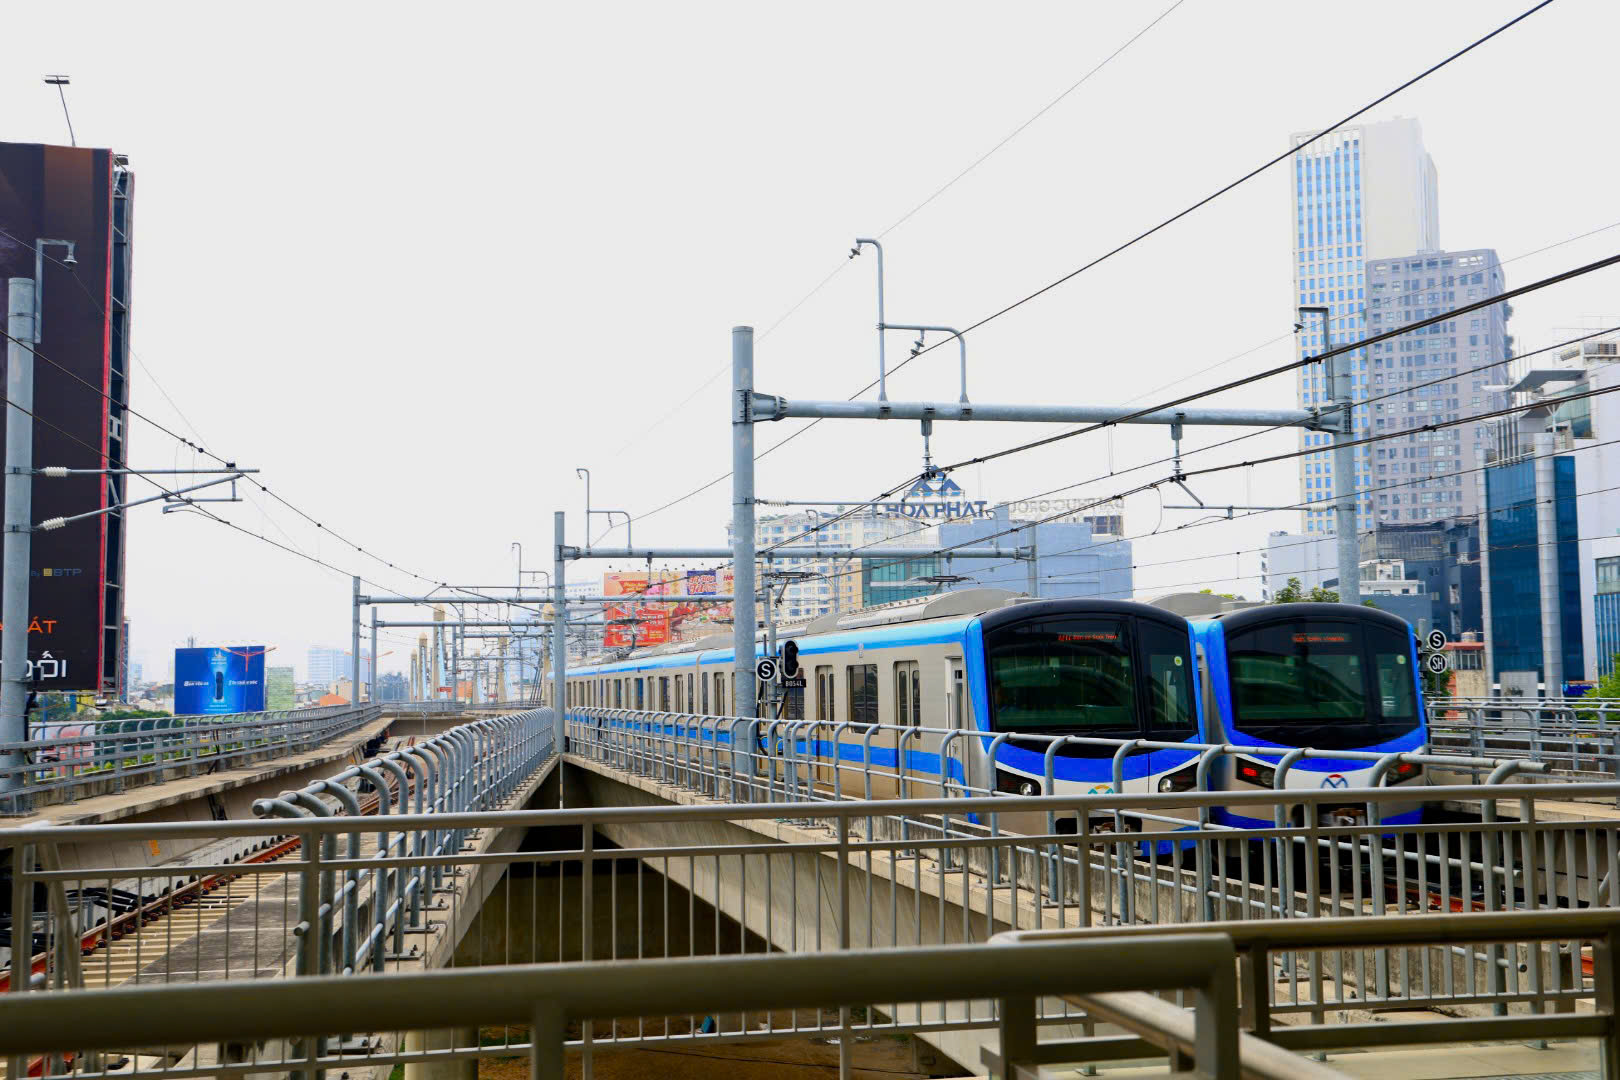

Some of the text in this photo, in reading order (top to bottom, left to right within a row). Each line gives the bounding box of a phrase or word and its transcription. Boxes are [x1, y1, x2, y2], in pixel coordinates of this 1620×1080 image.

[1432, 633, 1442, 647] S
[761, 663, 771, 677] S
[1432, 656, 1443, 670] SH
